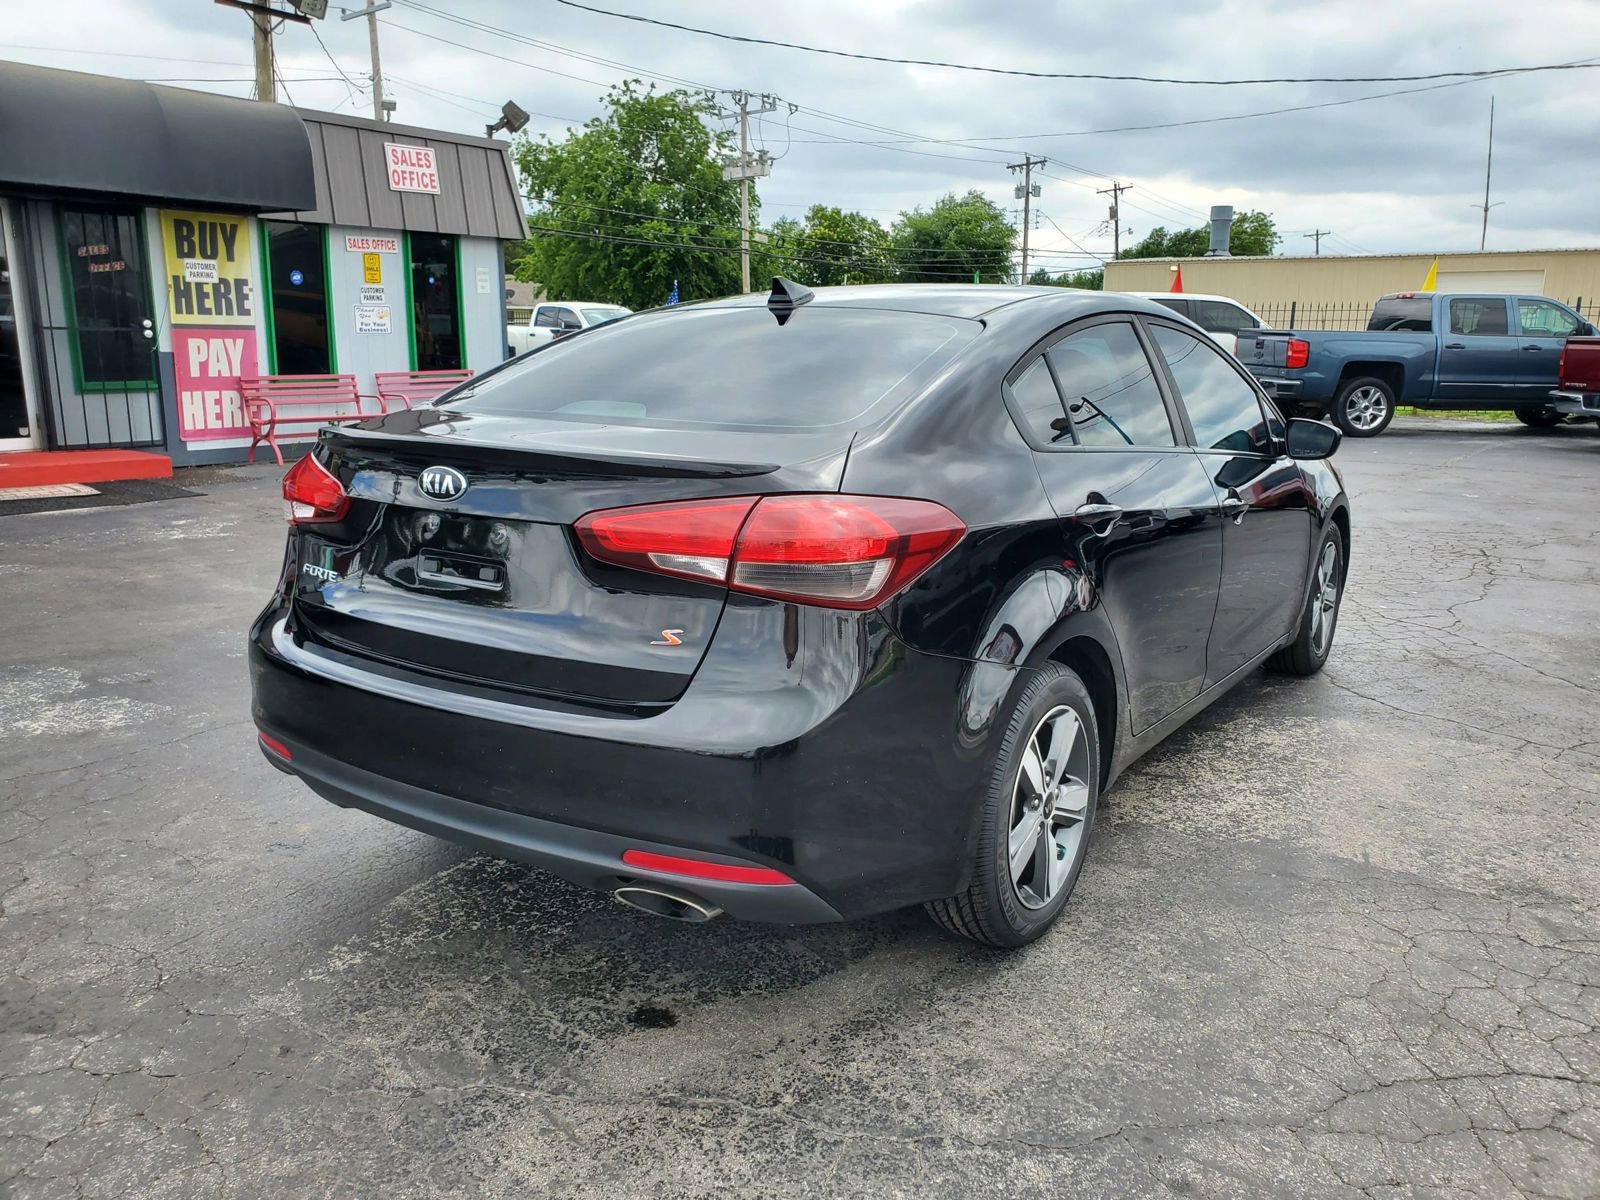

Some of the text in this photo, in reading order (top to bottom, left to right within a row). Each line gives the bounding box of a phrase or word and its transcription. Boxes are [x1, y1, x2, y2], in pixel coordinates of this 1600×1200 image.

[391, 148, 432, 169] SALES
[392, 169, 437, 189] OFFICE
[173, 218, 239, 262] BUY
[348, 238, 396, 250] SALES OFFICE
[185, 262, 217, 271] CUSTOMER
[189, 271, 214, 279] PARKING
[172, 275, 252, 317] HERE
[187, 338, 245, 378] PAY
[422, 472, 456, 494] KIA
[303, 562, 338, 582] FORTE
[650, 629, 684, 646] S
